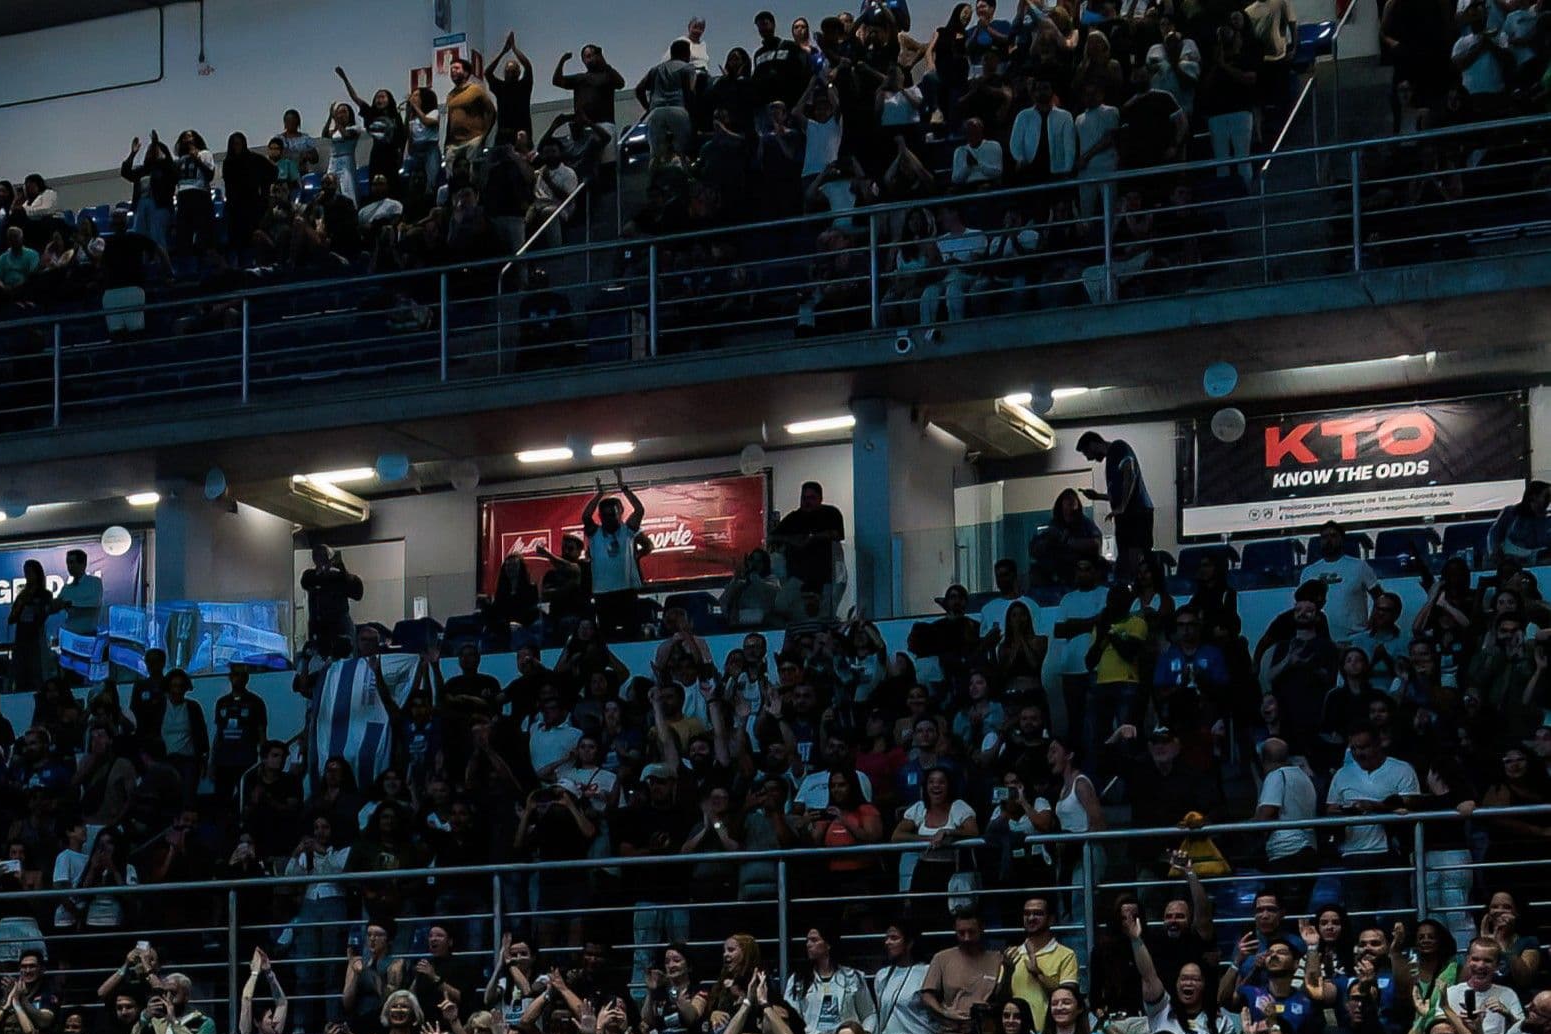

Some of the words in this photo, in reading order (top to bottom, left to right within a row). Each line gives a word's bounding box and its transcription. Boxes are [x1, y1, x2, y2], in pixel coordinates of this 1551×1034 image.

[1265, 411, 1437, 468] KTO
[1272, 468, 1333, 489] KNOW
[1335, 464, 1374, 483] THE
[1375, 460, 1430, 479] ODDS
